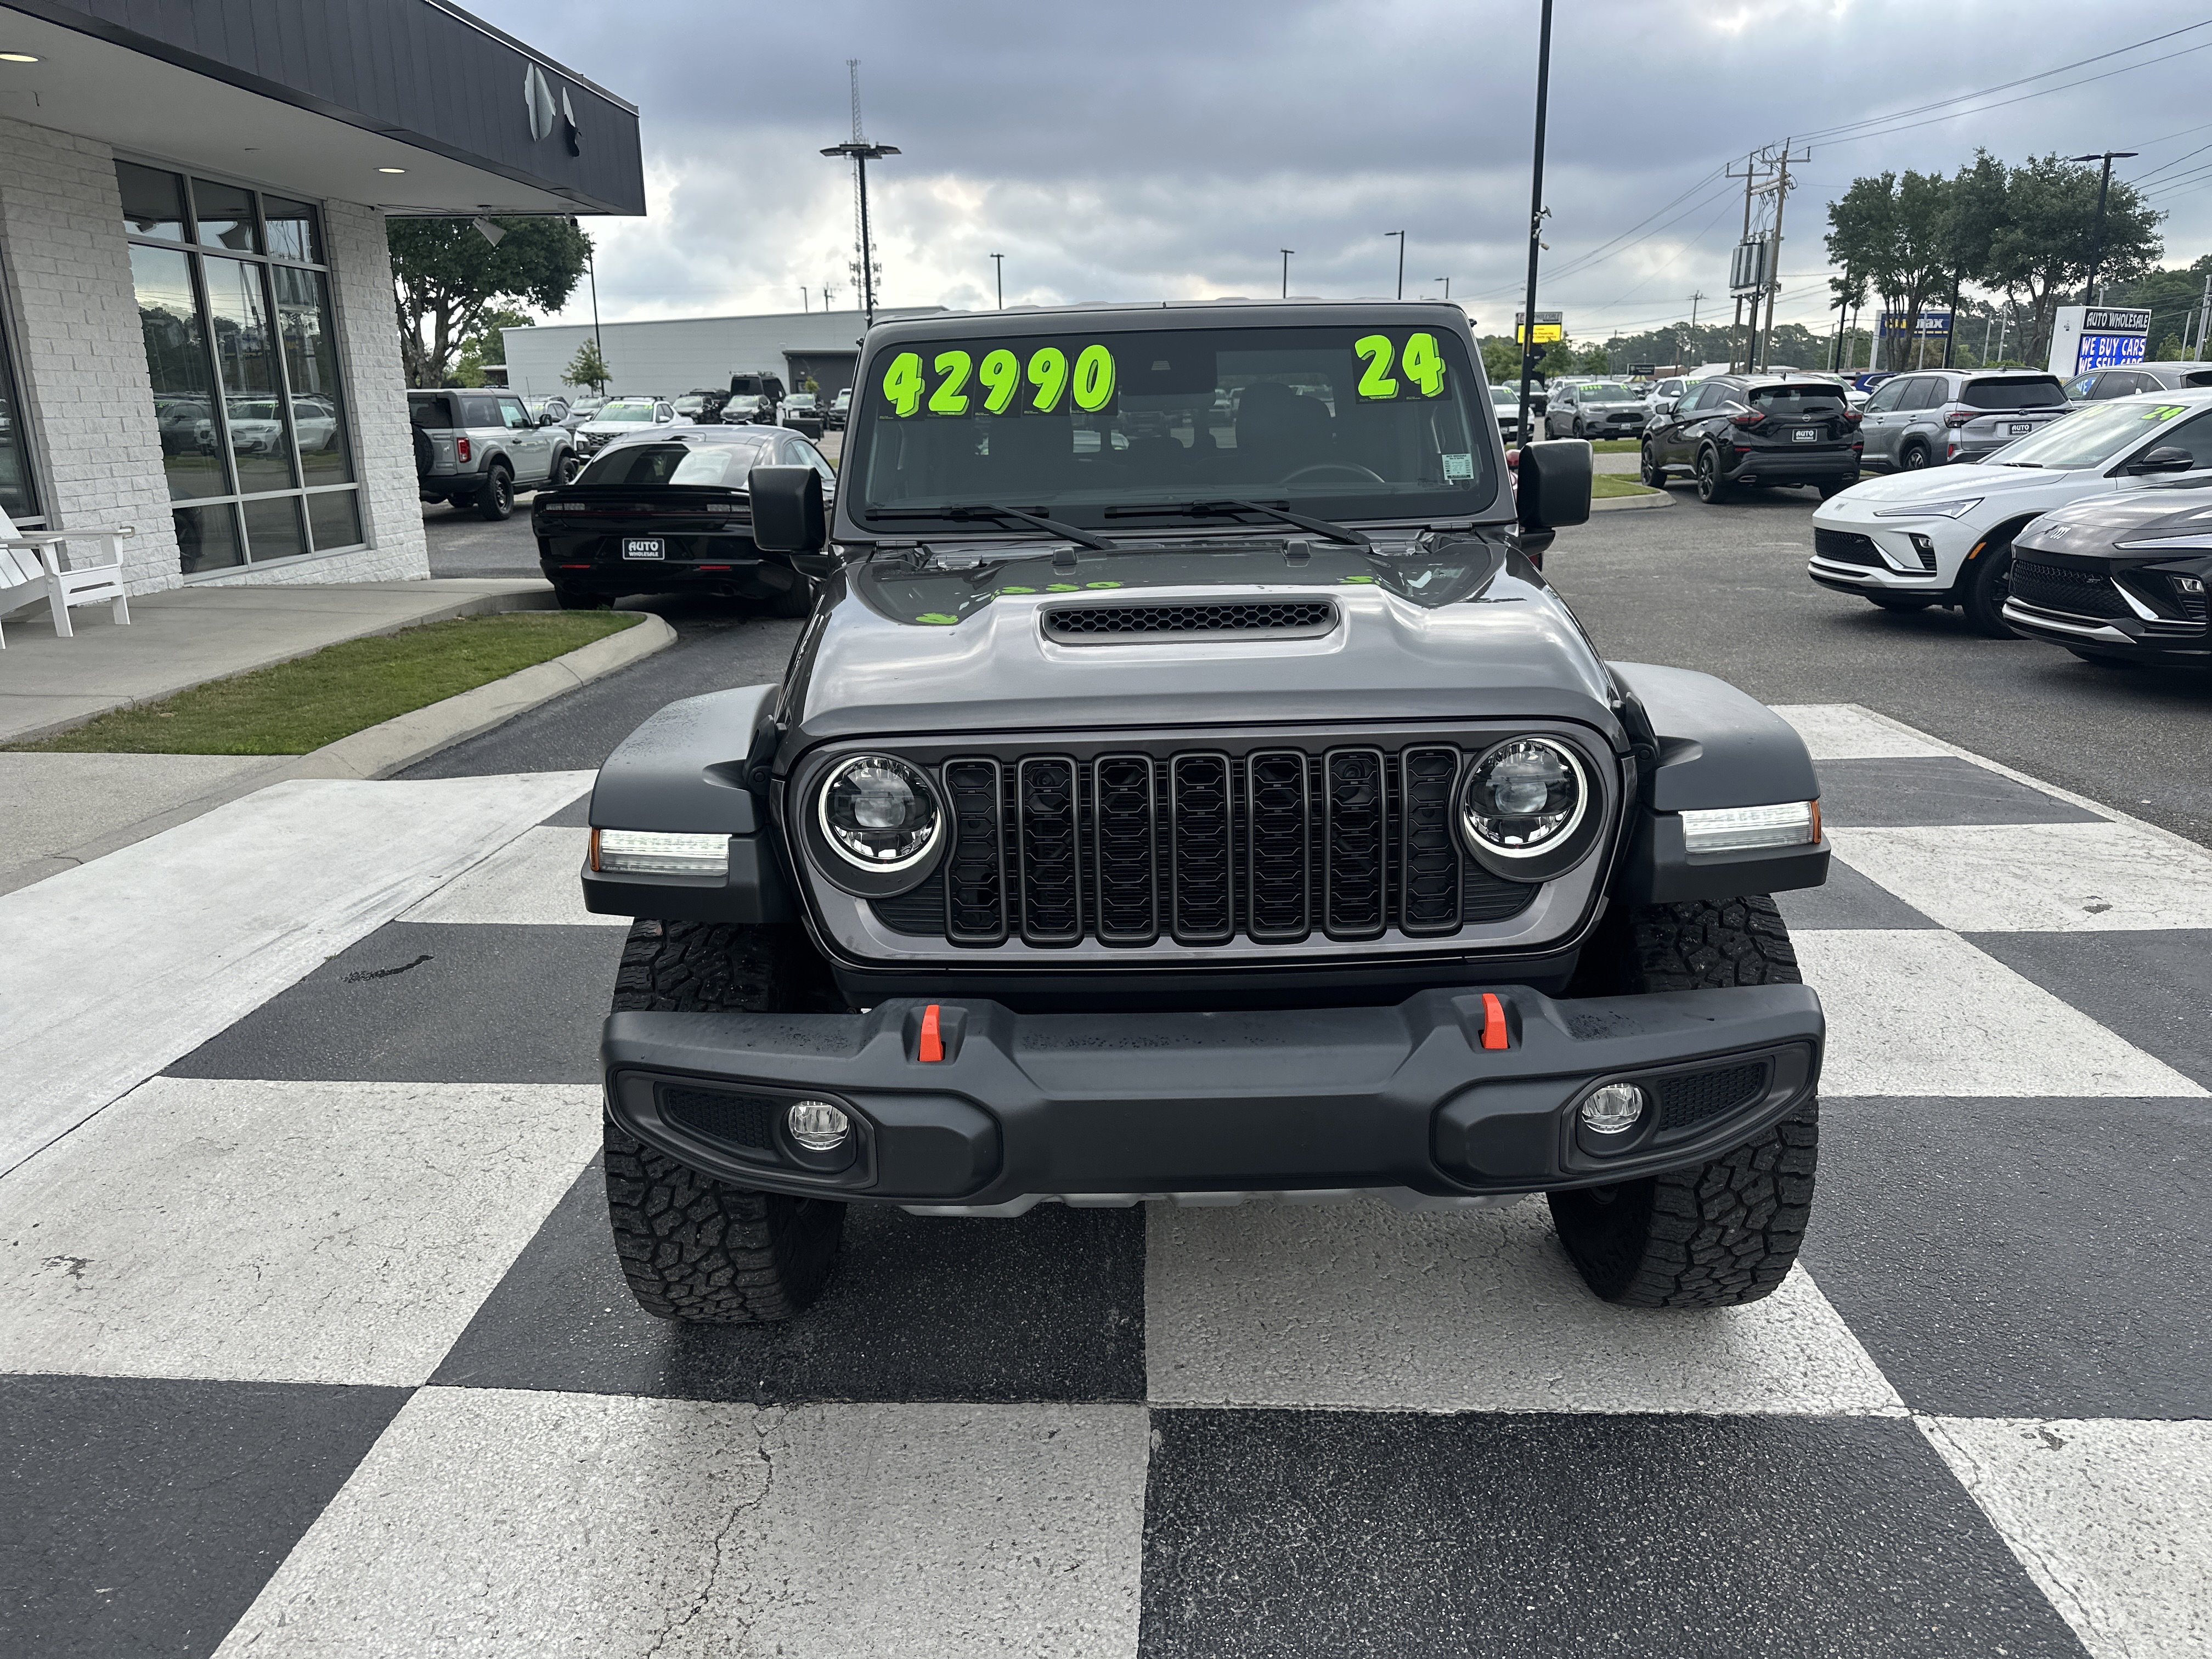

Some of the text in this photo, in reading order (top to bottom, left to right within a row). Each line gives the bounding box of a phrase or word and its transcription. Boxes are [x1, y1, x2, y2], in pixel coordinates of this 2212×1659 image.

[2086, 312, 2149, 329] AUTO WHOLESALE
[2081, 336, 2146, 357] WE BUY CARS
[1355, 332, 1446, 400] 24
[883, 344, 1116, 418] 42990
[2141, 406, 2185, 421] 24
[629, 541, 658, 551] AUTO
